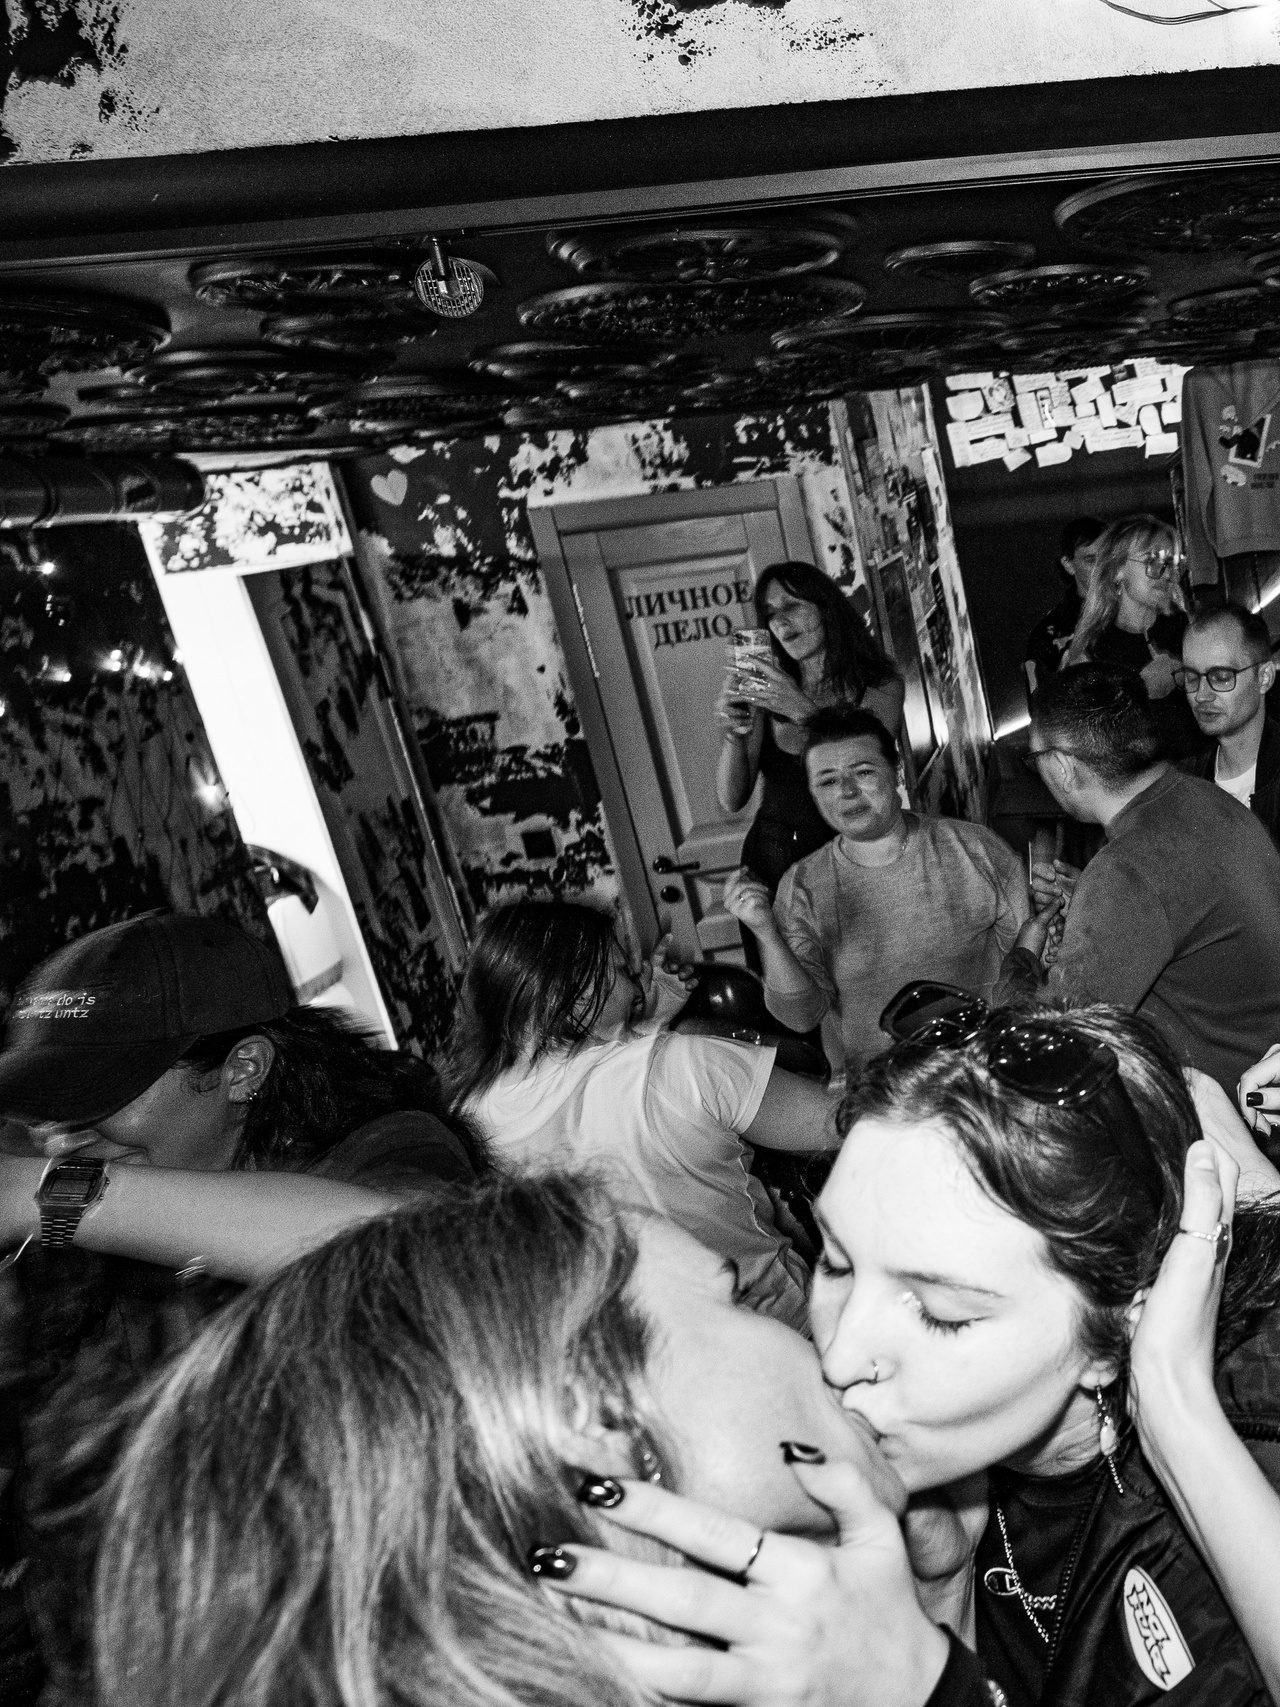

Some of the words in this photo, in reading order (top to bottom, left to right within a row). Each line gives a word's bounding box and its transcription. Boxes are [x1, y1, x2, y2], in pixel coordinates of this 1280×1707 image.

[625, 580, 752, 620] ЛИЧНОЕ
[652, 614, 733, 649] ДЕЛО
[54, 1007, 90, 1019] untz
[77, 992, 96, 1006] is
[1136, 1583, 1171, 1642] NO
[1126, 1584, 1171, 1686] FEAR
